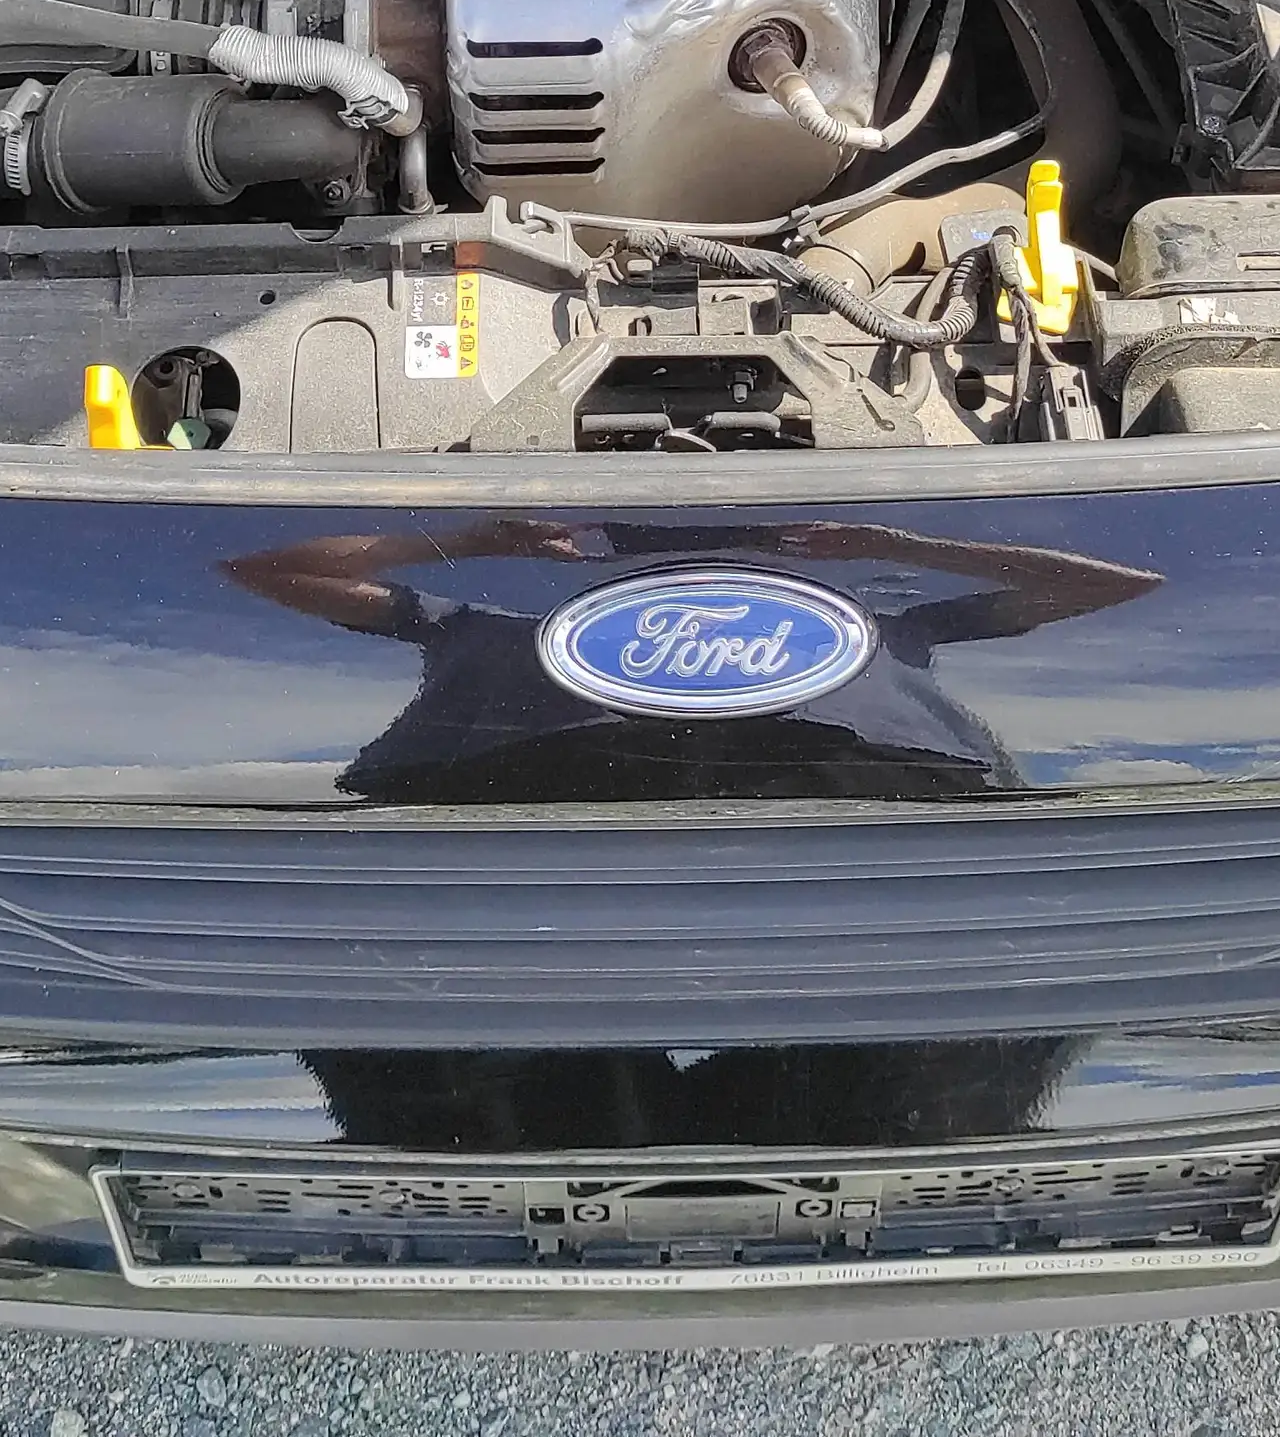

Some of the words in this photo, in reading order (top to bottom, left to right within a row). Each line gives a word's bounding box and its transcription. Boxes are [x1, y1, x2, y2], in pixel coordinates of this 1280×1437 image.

[620, 603, 791, 678] Ford
[253, 1273, 458, 1285] Autoreparatur
[469, 1274, 550, 1285] Frank
[560, 1274, 684, 1285] Bischoff
[729, 1271, 803, 1284] 76831
[817, 1266, 938, 1280] Billigheim
[1025, 1259, 1104, 1269] 06349
[1131, 1256, 1161, 1265] 96
[1171, 1254, 1201, 1264] 39
[1211, 1252, 1260, 1262] 990
